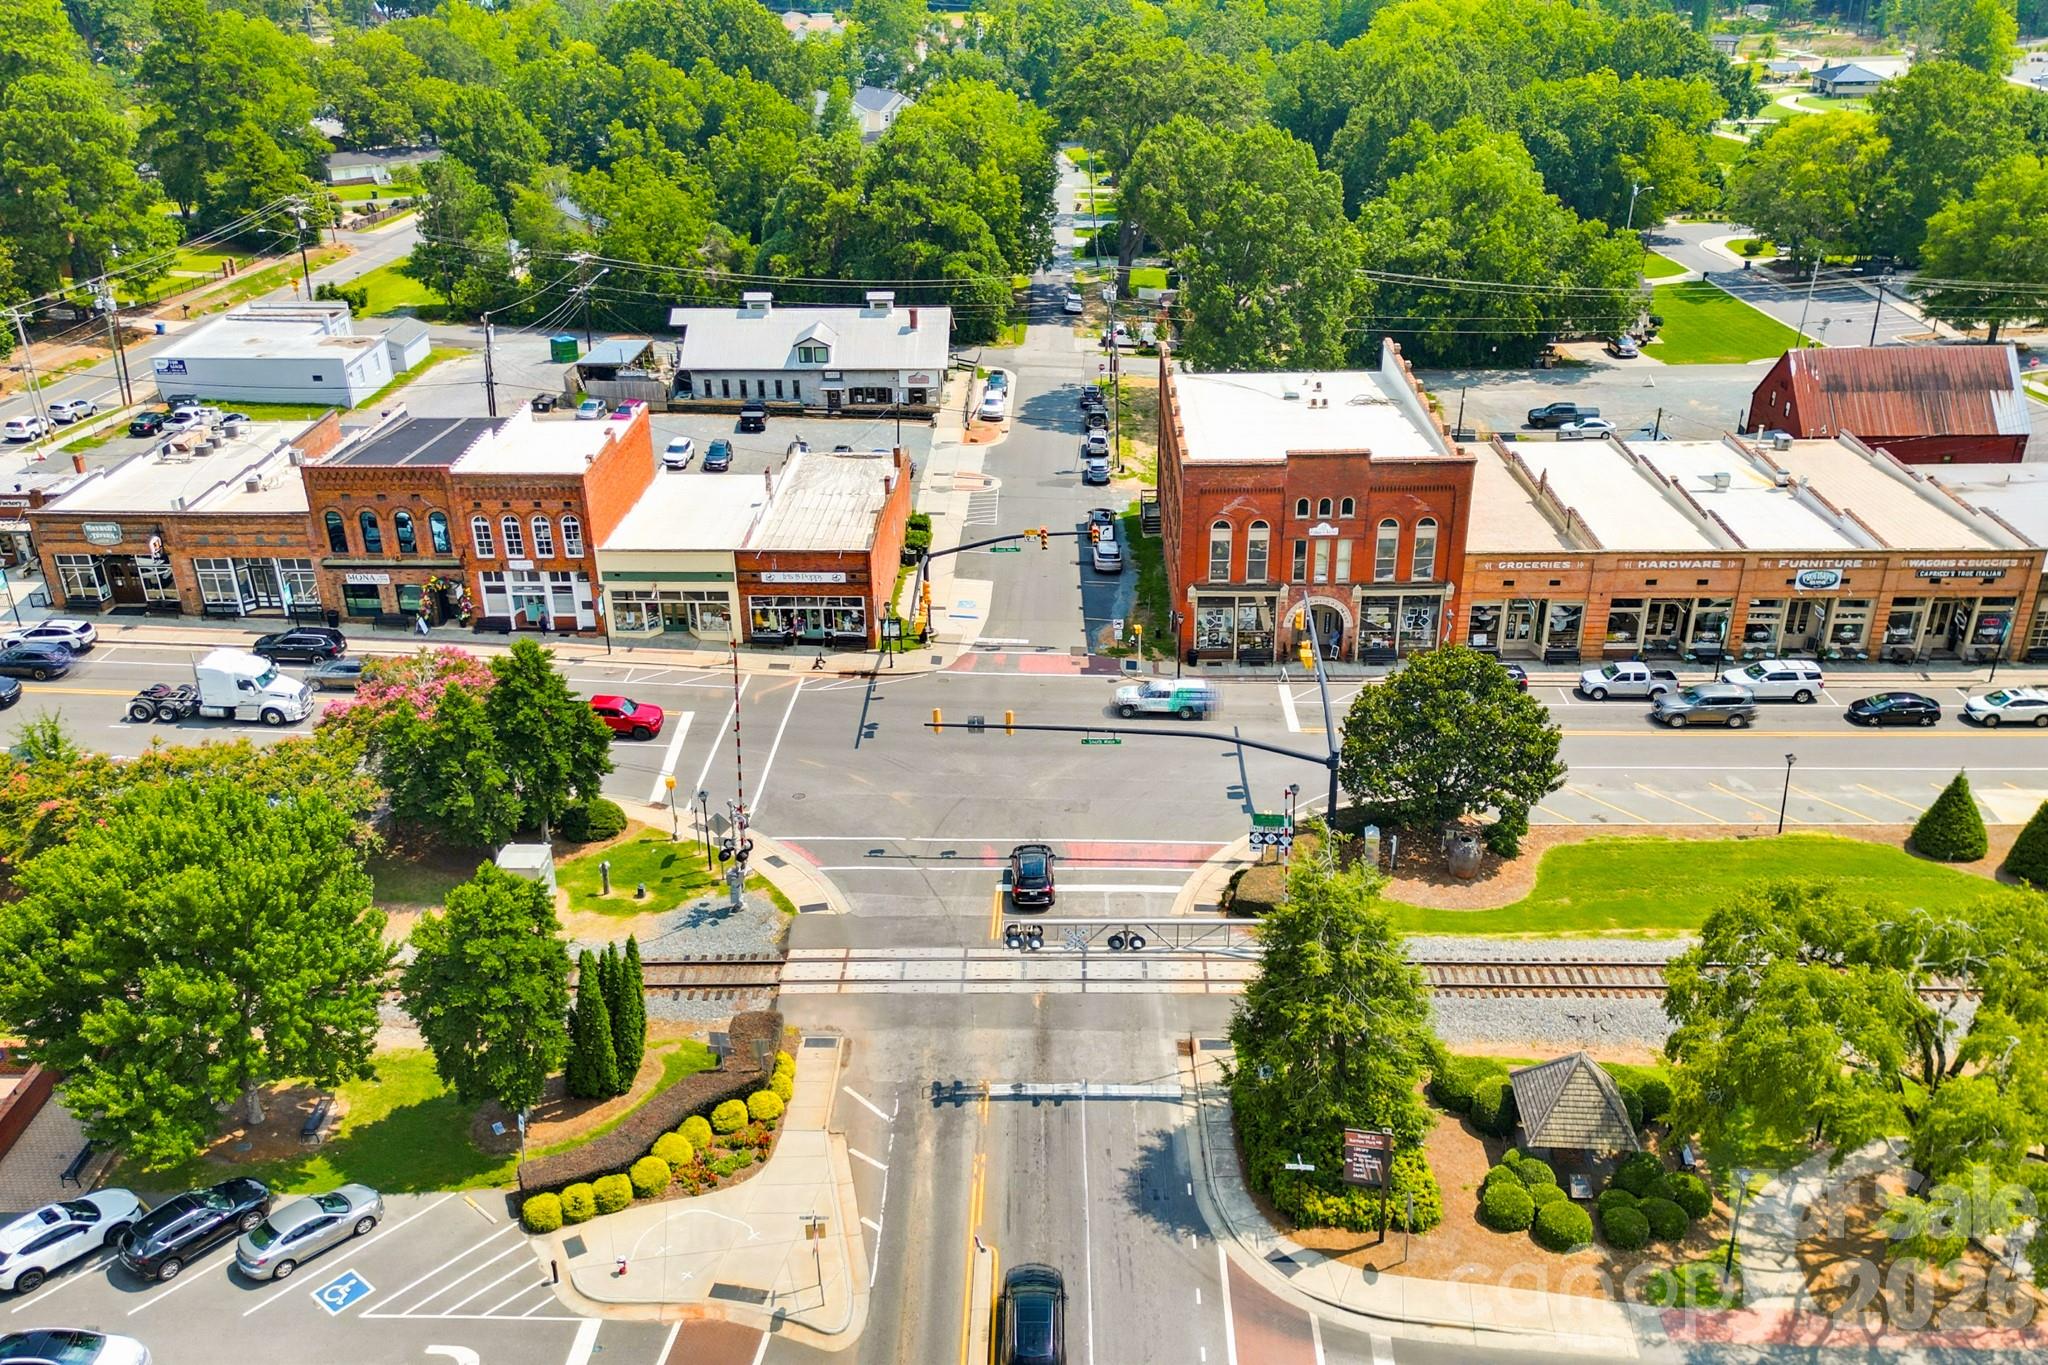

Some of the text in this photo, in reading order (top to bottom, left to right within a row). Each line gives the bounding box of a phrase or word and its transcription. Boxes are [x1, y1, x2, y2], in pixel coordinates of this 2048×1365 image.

[1498, 561, 1571, 569] GROCERIES
[1638, 560, 1722, 568] HARDWARE
[1778, 559, 1863, 568] FURNITURE
[1909, 559, 2018, 567] WAGONS & BUGGIES
